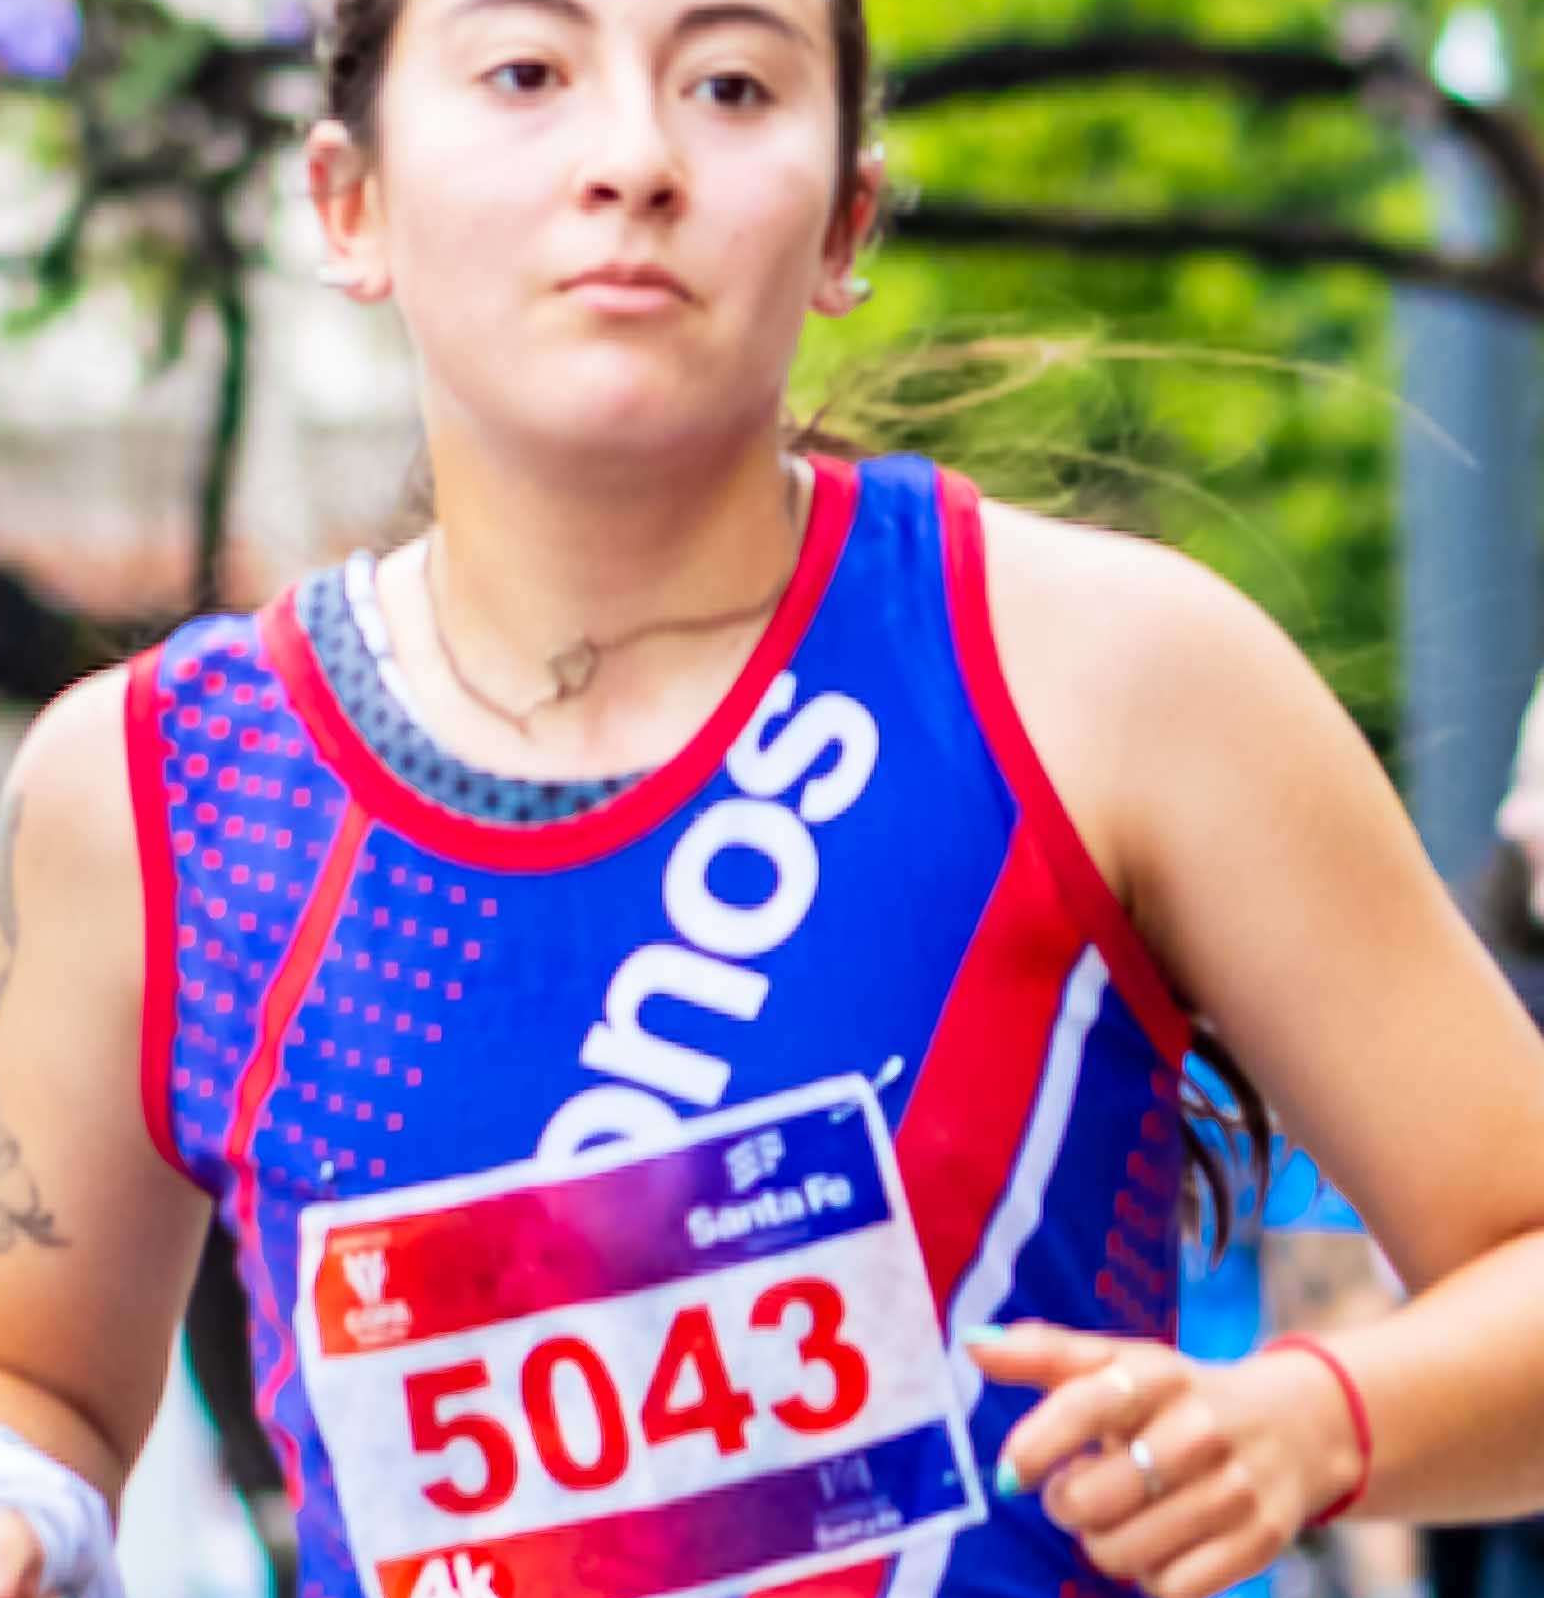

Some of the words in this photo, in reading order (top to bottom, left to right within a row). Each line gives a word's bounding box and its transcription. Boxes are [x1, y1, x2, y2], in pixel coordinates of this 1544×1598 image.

[687, 1188, 804, 1250] Santa
[805, 1171, 853, 1215] Fe
[402, 1274, 870, 1516] 5043
